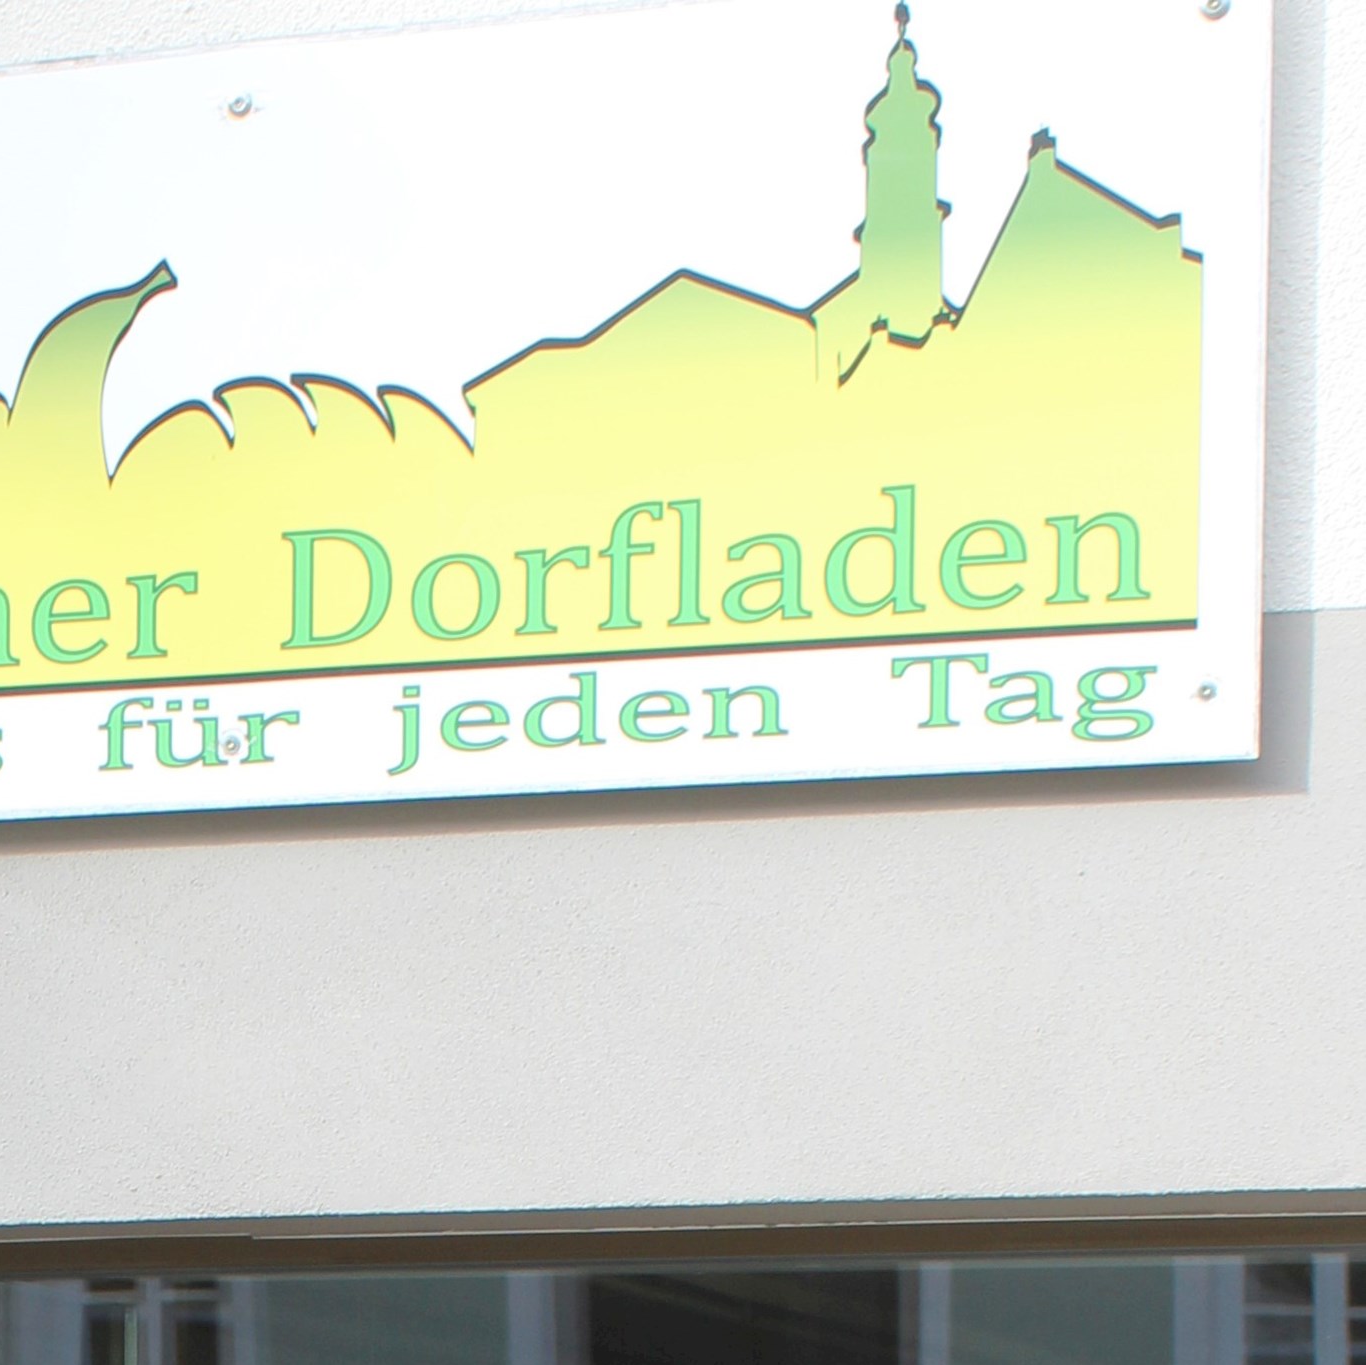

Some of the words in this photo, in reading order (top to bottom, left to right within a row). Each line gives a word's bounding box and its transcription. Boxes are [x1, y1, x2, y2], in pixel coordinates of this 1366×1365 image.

[280, 485, 1152, 650] Dorfladen
[98, 697, 301, 773] für
[388, 671, 789, 776] jeden
[890, 652, 1158, 742] Tag
